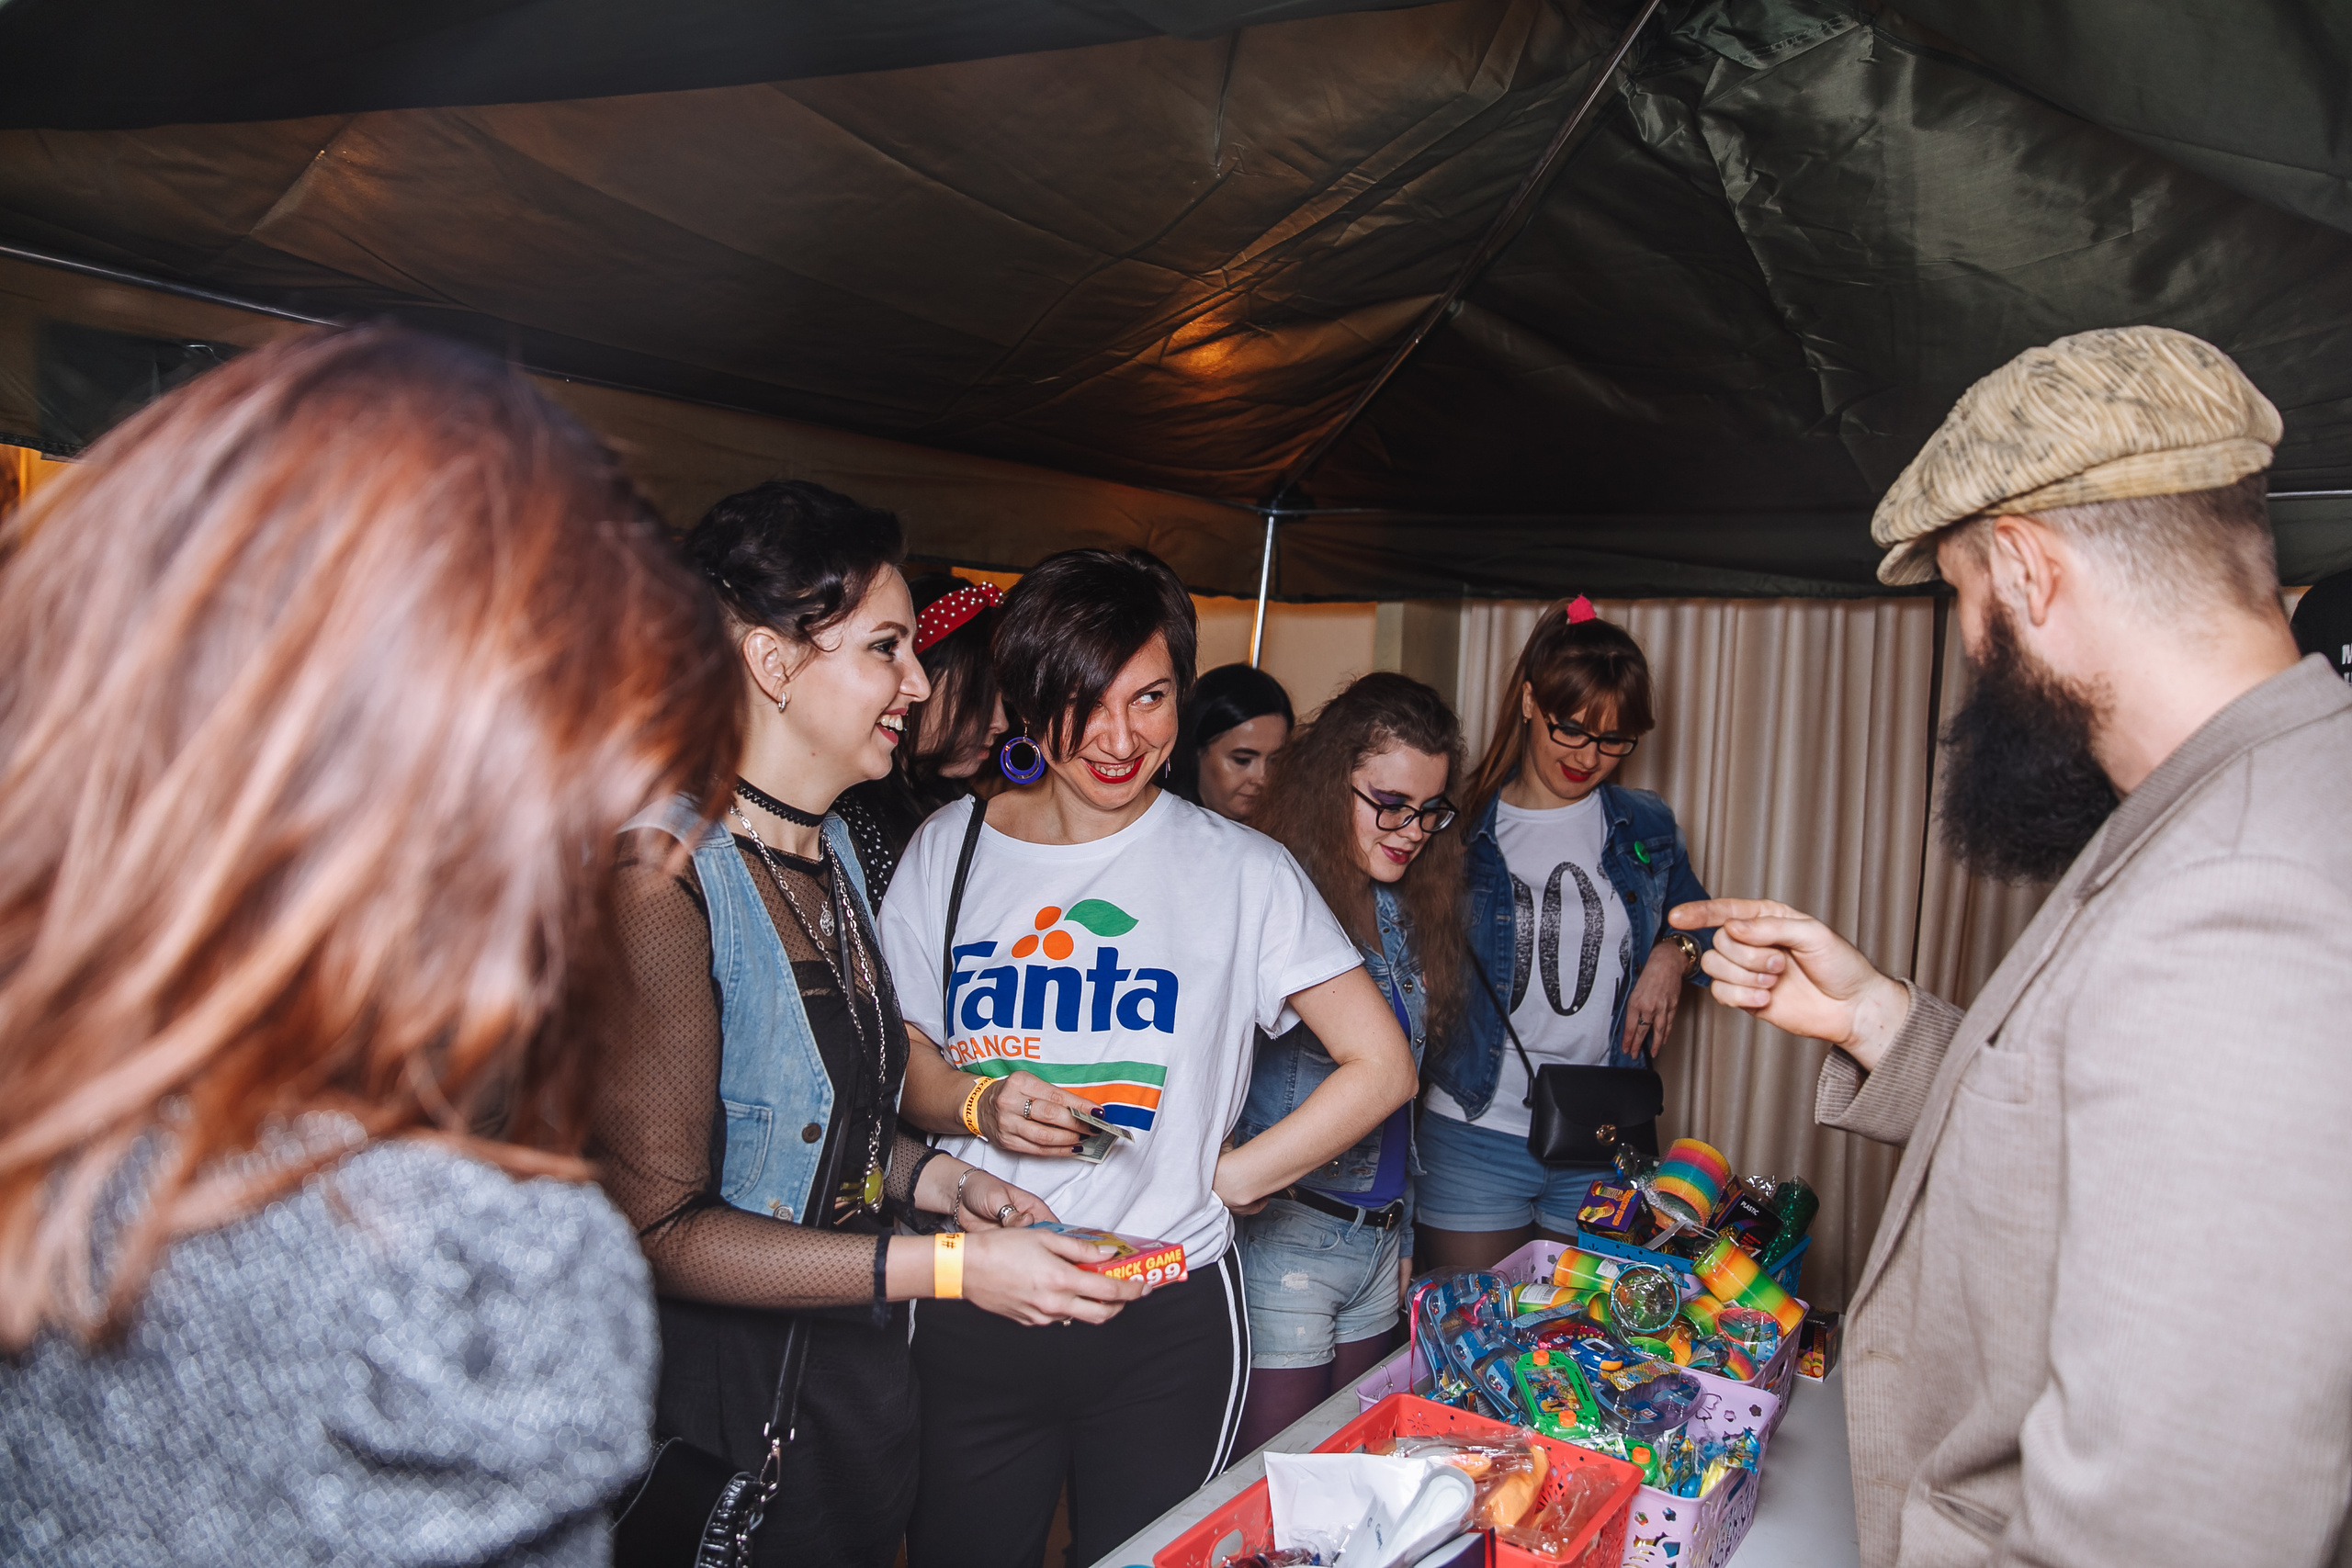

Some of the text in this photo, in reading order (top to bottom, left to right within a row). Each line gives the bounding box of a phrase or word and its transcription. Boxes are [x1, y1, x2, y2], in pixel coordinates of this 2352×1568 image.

[946, 940, 1180, 1038] Fanta
[949, 1034, 1041, 1065] ORANGE
[1740, 1201, 1760, 1216] PLASTIC
[1145, 1248, 1182, 1270] GAME
